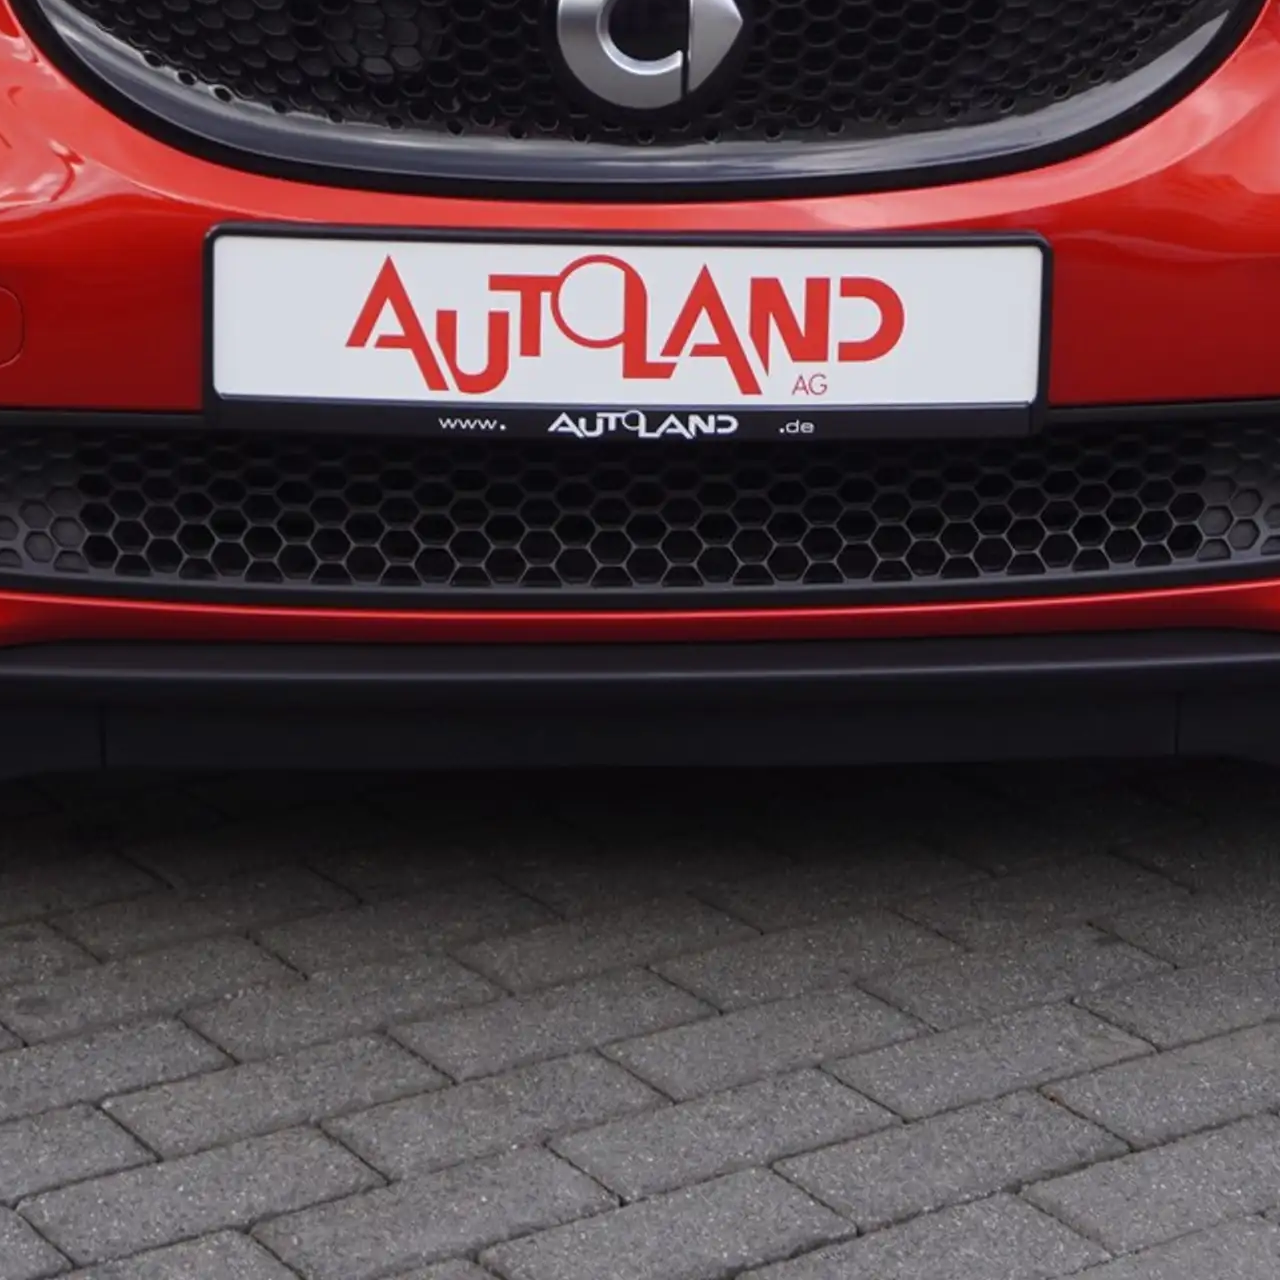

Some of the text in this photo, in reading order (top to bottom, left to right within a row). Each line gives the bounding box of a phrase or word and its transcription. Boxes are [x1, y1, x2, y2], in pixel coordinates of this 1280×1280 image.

[346, 254, 905, 395] AUTOLAND
[792, 374, 828, 396] AG
[548, 410, 739, 439] AUTOLAND
